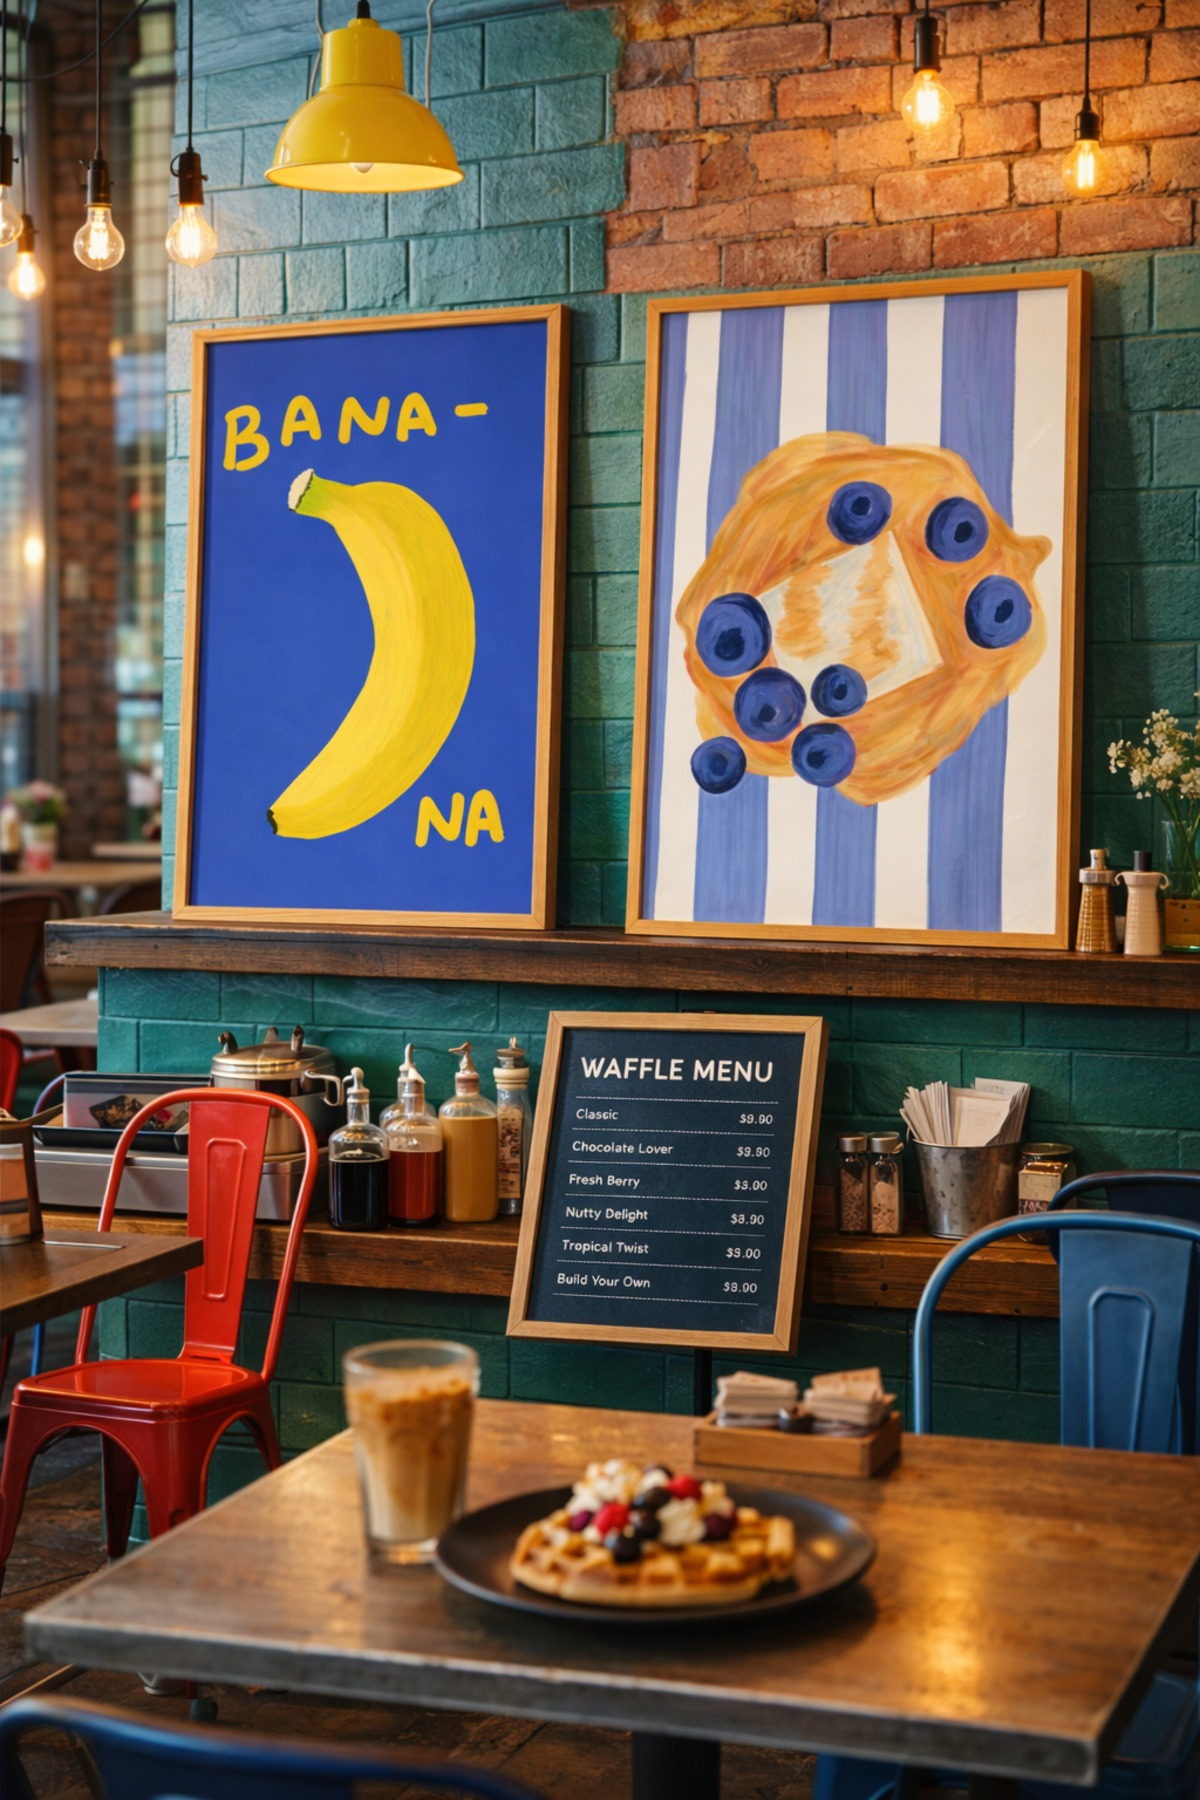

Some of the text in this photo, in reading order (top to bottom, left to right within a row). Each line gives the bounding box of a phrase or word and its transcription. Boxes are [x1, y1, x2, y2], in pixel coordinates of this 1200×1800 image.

[415, 789, 505, 848] NA
[581, 1057, 773, 1083] WAFFLE MENU
[576, 1109, 618, 1120] Classic
[572, 1141, 635, 1153] Chocolate
[639, 1144, 673, 1155] Lover
[569, 1174, 602, 1186] Fresh
[608, 1176, 640, 1189] Berry
[566, 1207, 601, 1220] Nutty
[606, 1208, 648, 1223] Delight
[562, 1239, 612, 1254] Tropical
[616, 1242, 649, 1254] Twist
[557, 1273, 587, 1285] Build
[592, 1275, 619, 1287] Your
[623, 1276, 650, 1288] Own
